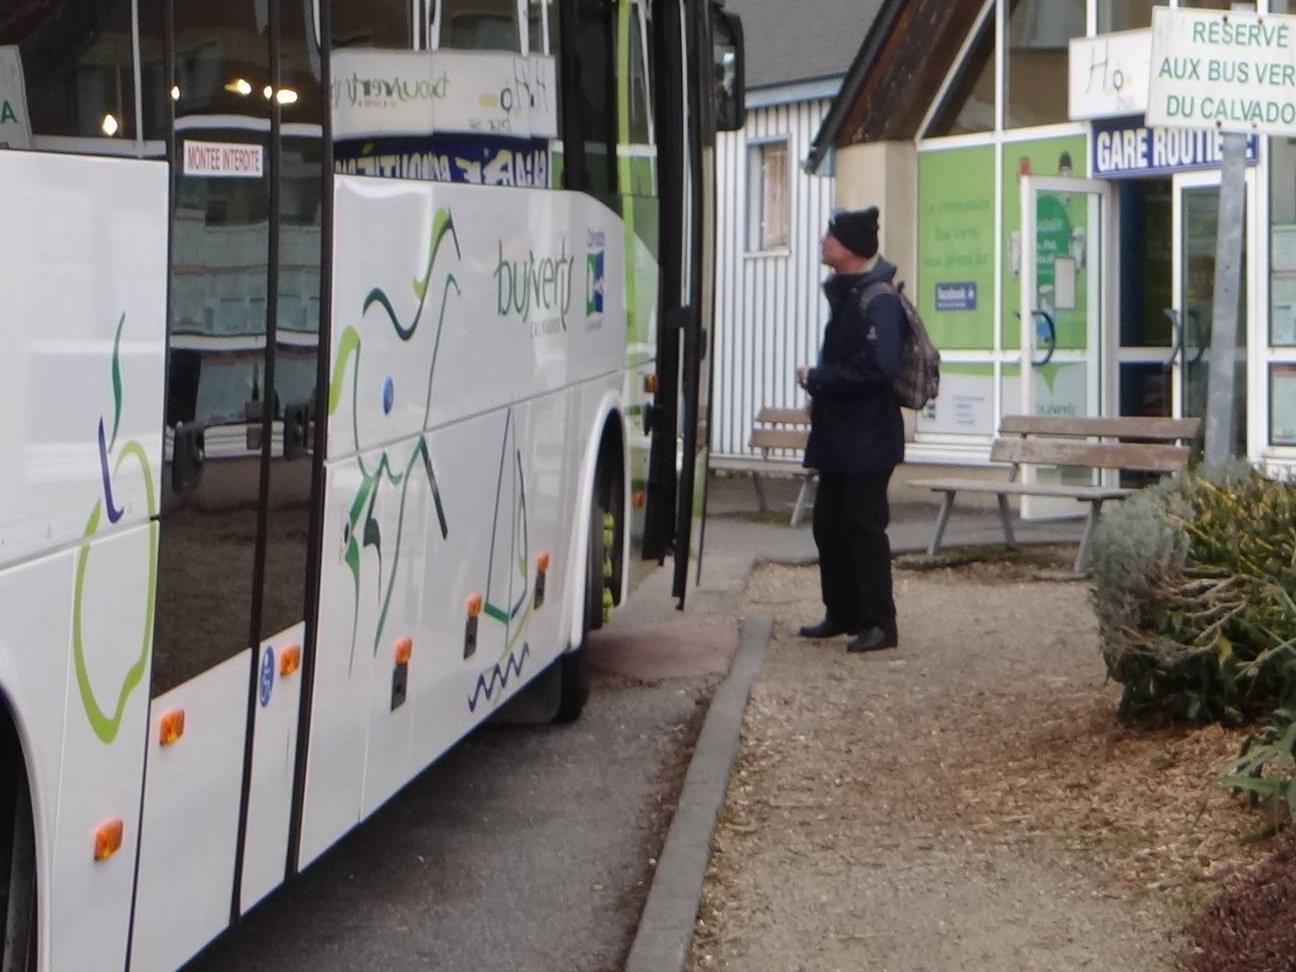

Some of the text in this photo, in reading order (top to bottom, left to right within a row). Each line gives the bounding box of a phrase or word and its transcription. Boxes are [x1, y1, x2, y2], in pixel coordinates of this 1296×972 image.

[1193, 19, 1288, 48] RÉSERVÉ
[1159, 57, 1200, 81] AUX
[1208, 59, 1249, 84] BUS
[1166, 94, 1194, 118] DU
[223, 148, 260, 172] INTERDITE
[1096, 129, 1148, 172] GARE
